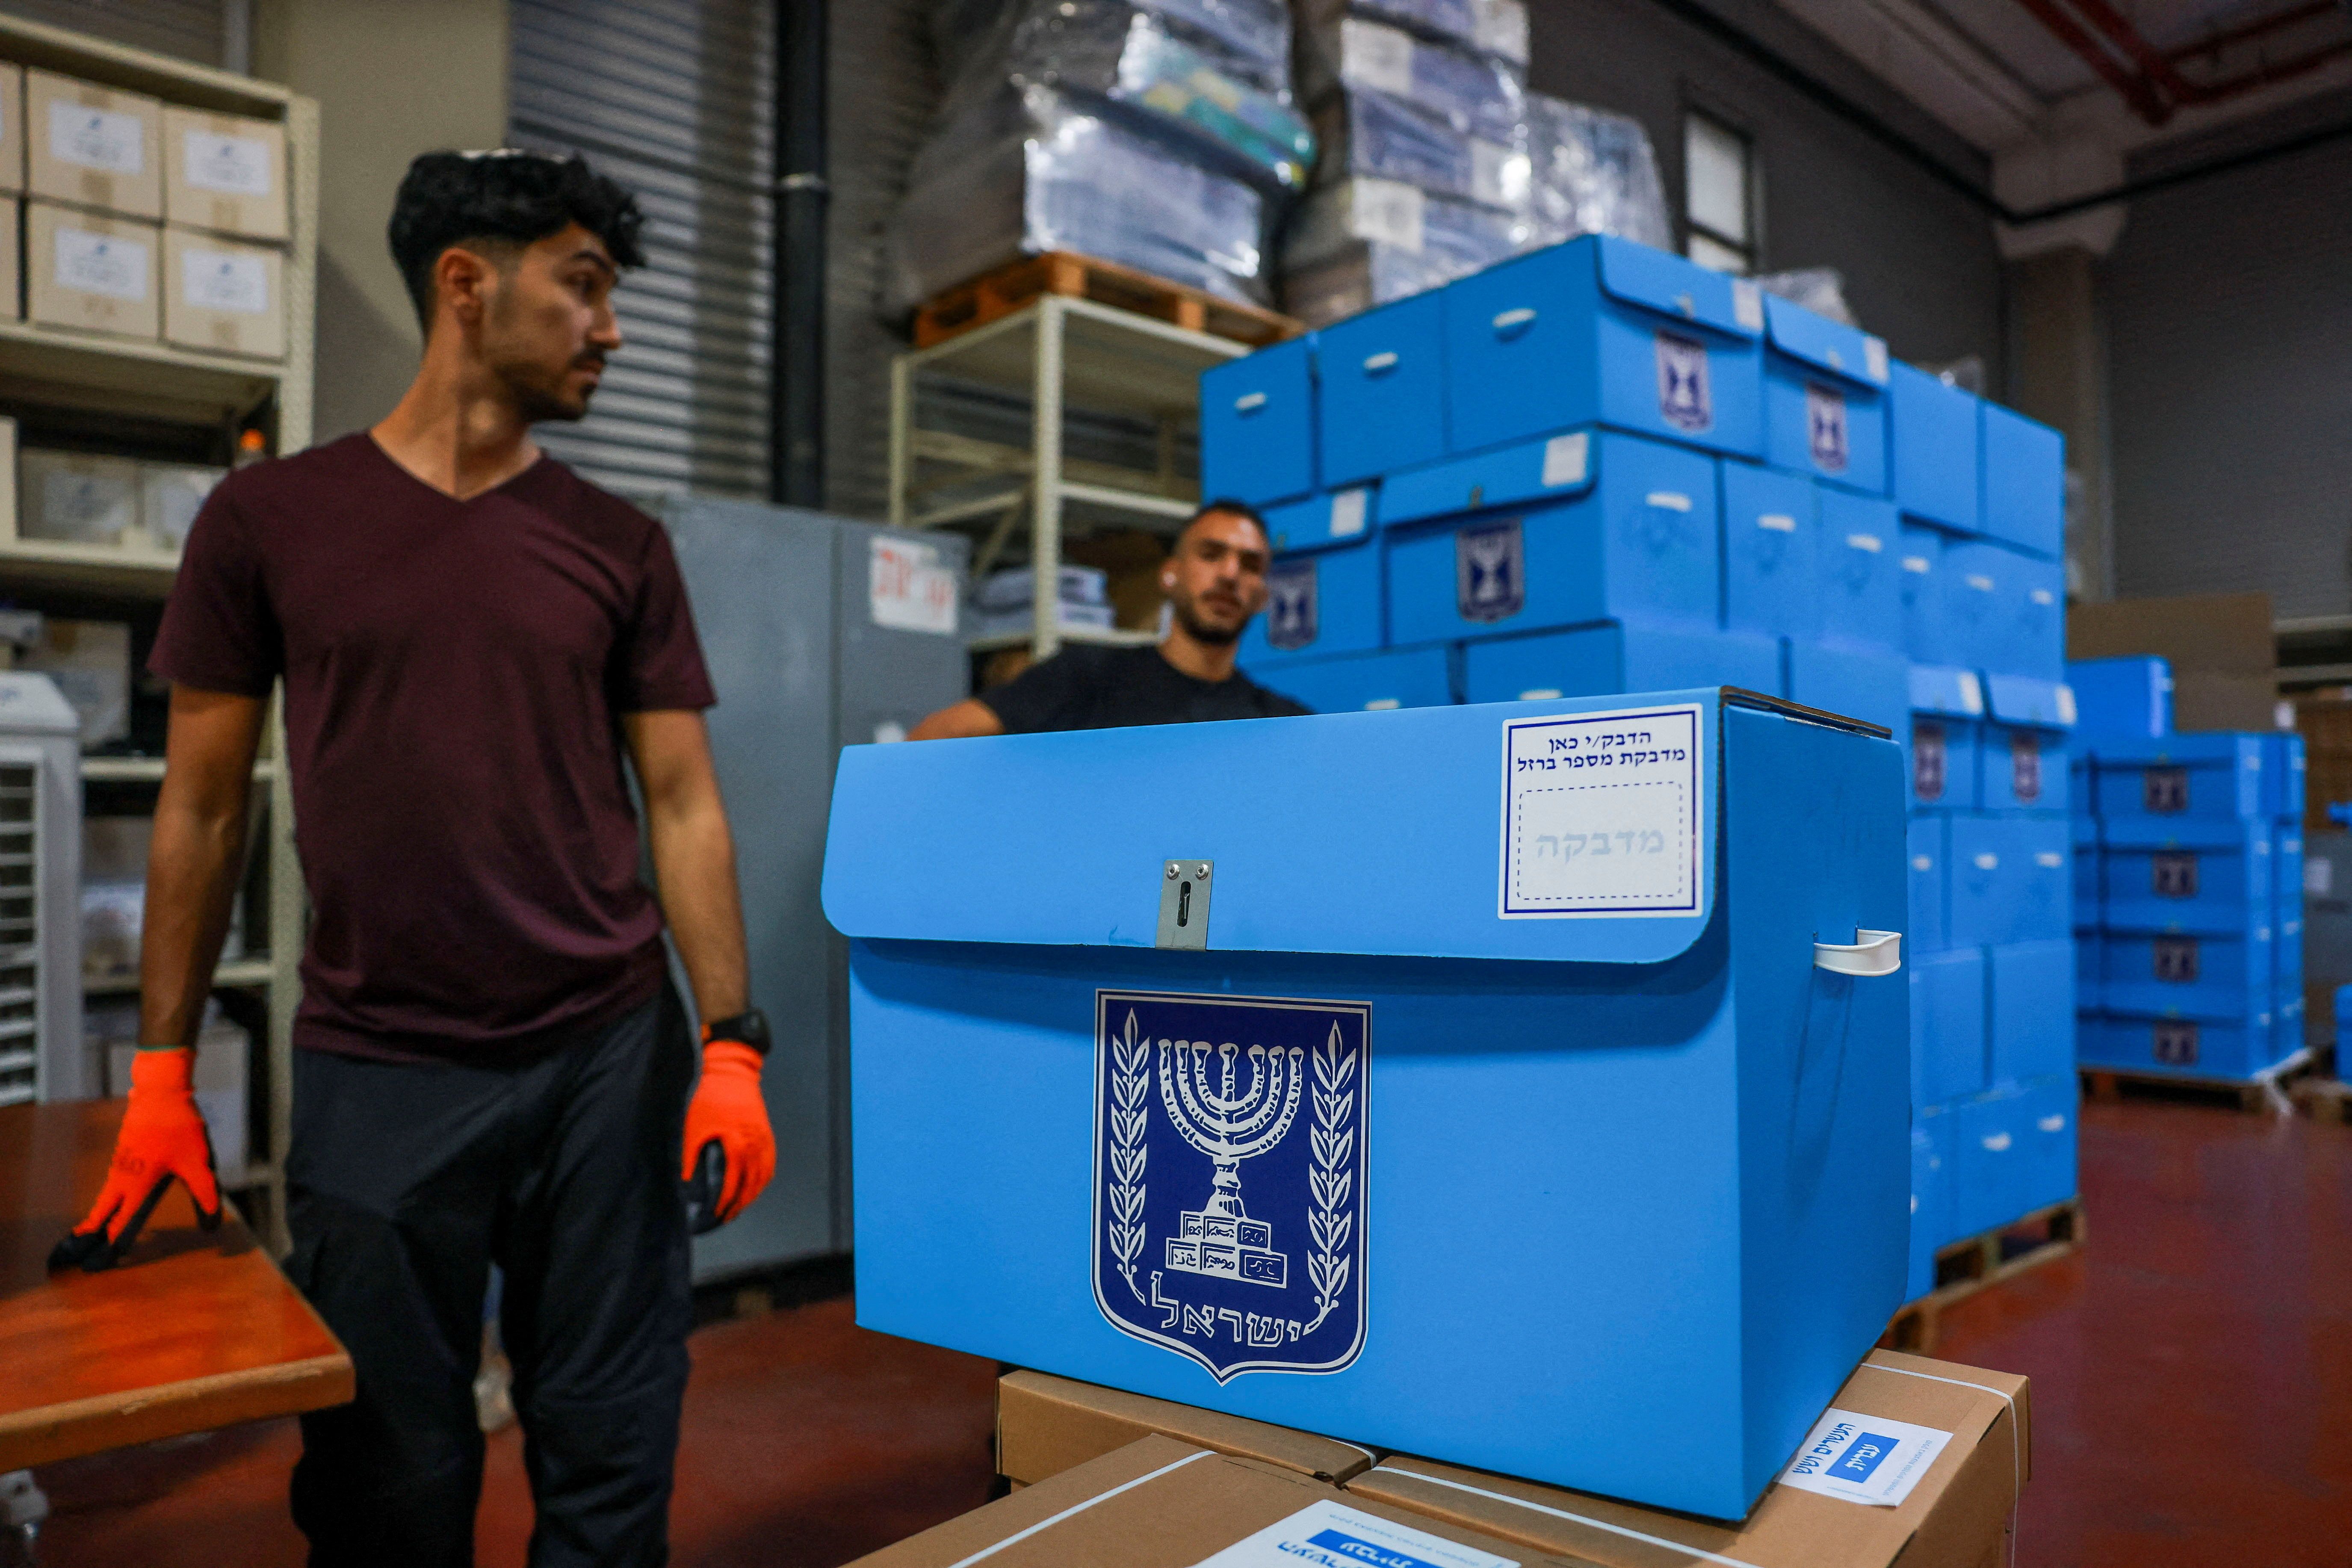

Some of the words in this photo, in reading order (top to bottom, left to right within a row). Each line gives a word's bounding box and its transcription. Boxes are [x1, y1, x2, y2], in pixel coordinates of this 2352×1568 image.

[1548, 738, 1578, 754] כאן
[1585, 732, 1651, 750] הדבק/י
[1517, 757, 1556, 772] ברזל
[1563, 753, 1613, 768] מספר
[1619, 749, 1686, 767] מדבקת
[1535, 829, 1664, 864] מדבקה
[1150, 1270, 1301, 1347] ישראל
[1811, 1423, 1856, 1455] העשרים
[1792, 1456, 1824, 1474] ושש
[1844, 1443, 1881, 1471] עברית
